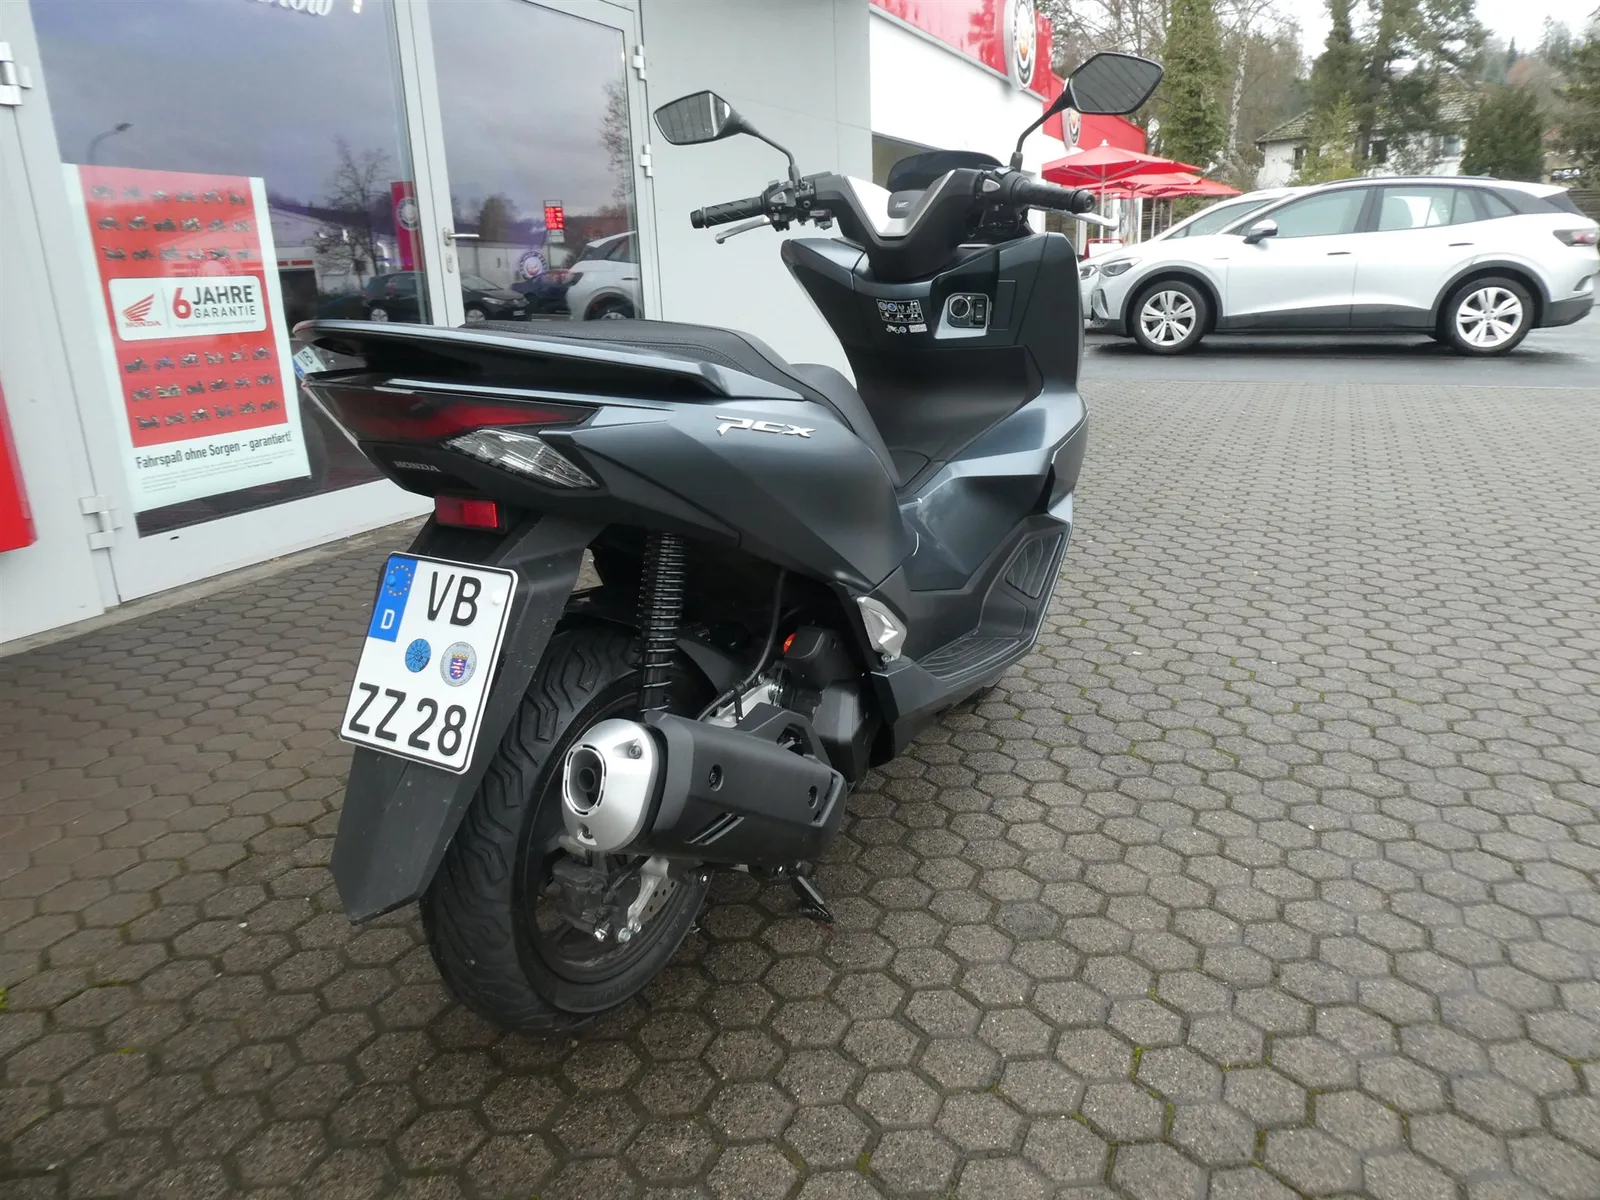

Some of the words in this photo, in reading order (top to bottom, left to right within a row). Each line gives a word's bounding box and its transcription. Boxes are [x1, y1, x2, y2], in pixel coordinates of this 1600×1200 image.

[173, 287, 191, 319] 6
[193, 285, 254, 305] JAHRE
[195, 306, 256, 319] GARANTIE
[715, 414, 816, 438] PCX
[135, 449, 183, 469] Fahrspaß
[184, 447, 208, 461] ohne
[209, 442, 241, 457] Sorgen
[392, 460, 442, 473] HONDA
[427, 570, 482, 627] VB
[380, 608, 395, 630] D
[348, 682, 407, 742] ZZ
[407, 697, 468, 757] 28
